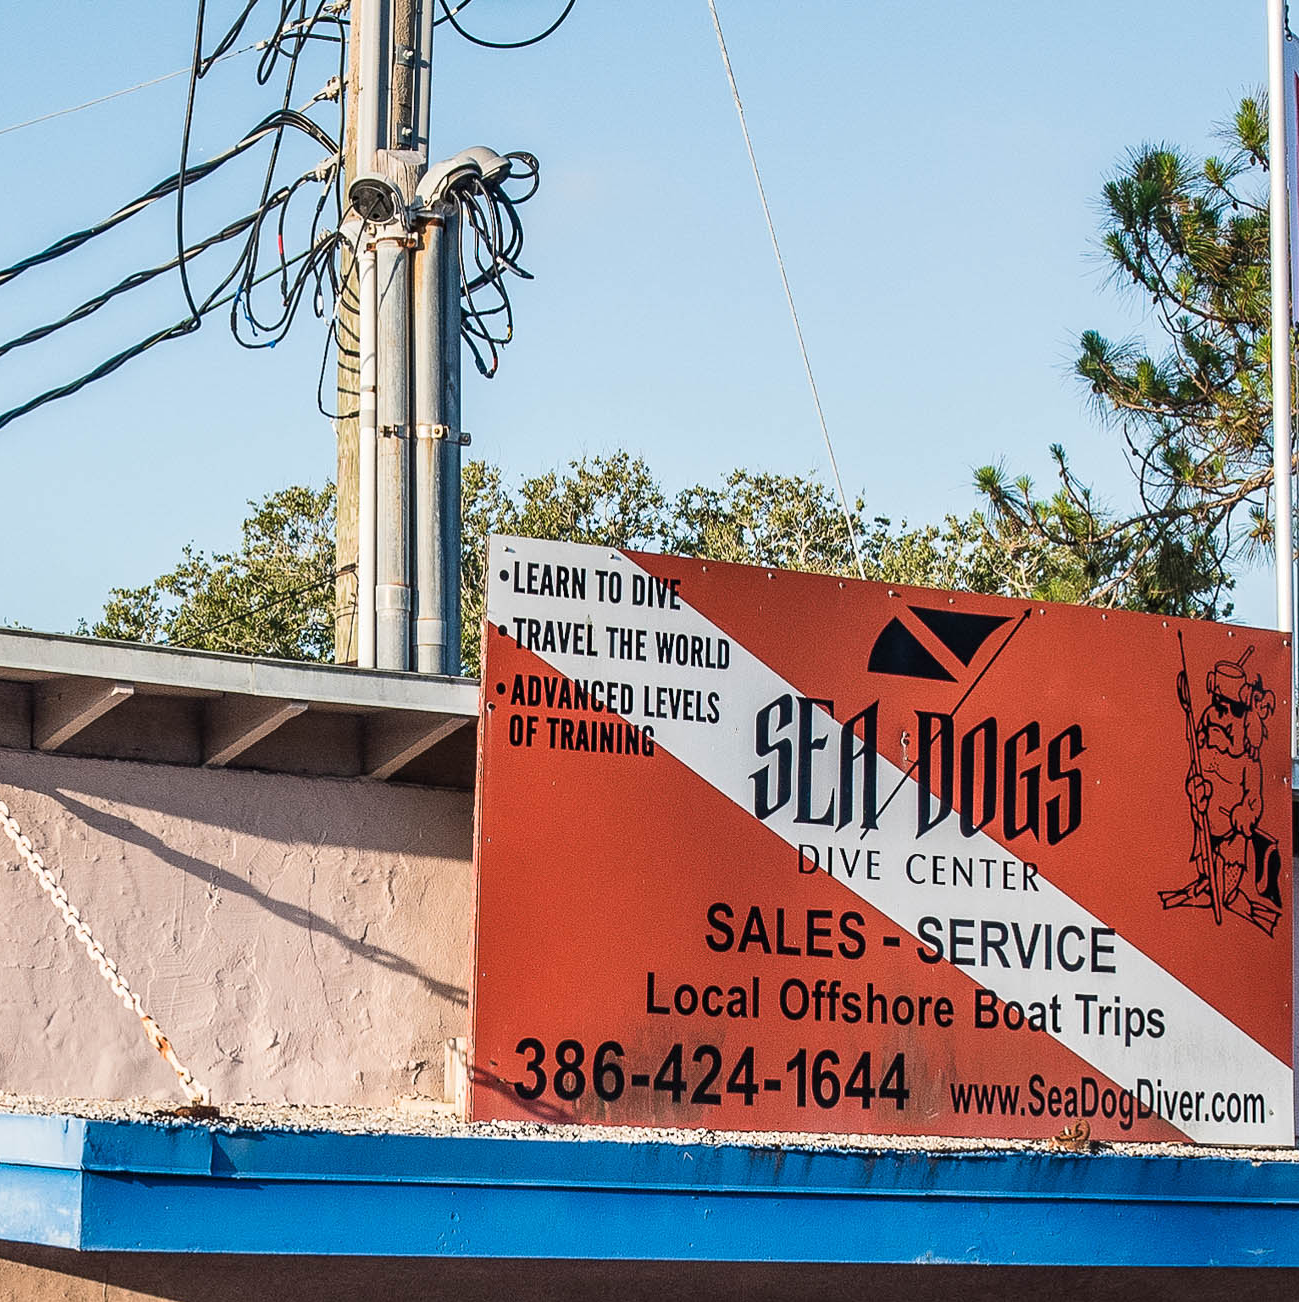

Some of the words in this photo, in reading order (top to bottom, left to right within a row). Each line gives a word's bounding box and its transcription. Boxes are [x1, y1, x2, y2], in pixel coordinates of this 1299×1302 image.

[513, 561, 587, 600] LEARN
[595, 569, 622, 604] TO
[632, 574, 682, 610] DIVE
[512, 617, 599, 657] TRAVEL
[605, 626, 648, 662] THE
[655, 631, 731, 670] WORLD
[510, 674, 634, 715] ADVANCED
[643, 685, 721, 724] LEVELS
[509, 714, 538, 748] OF
[546, 717, 656, 757] TRAINING
[748, 693, 881, 834] SEA
[914, 709, 1088, 847] DOGS
[798, 844, 881, 881] DIVE
[905, 853, 1041, 892] CENTER
[705, 902, 867, 961] SALES
[882, 936, 901, 947] -
[916, 917, 1117, 974] SERVICE
[646, 971, 761, 1019] Local
[779, 978, 955, 1027] Offshore
[974, 988, 1062, 1034] Boat
[1075, 992, 1167, 1048] Trips
[513, 1037, 911, 1110] 386-424-1644
[950, 1073, 1266, 1131] www.SeaDogDiver.com
